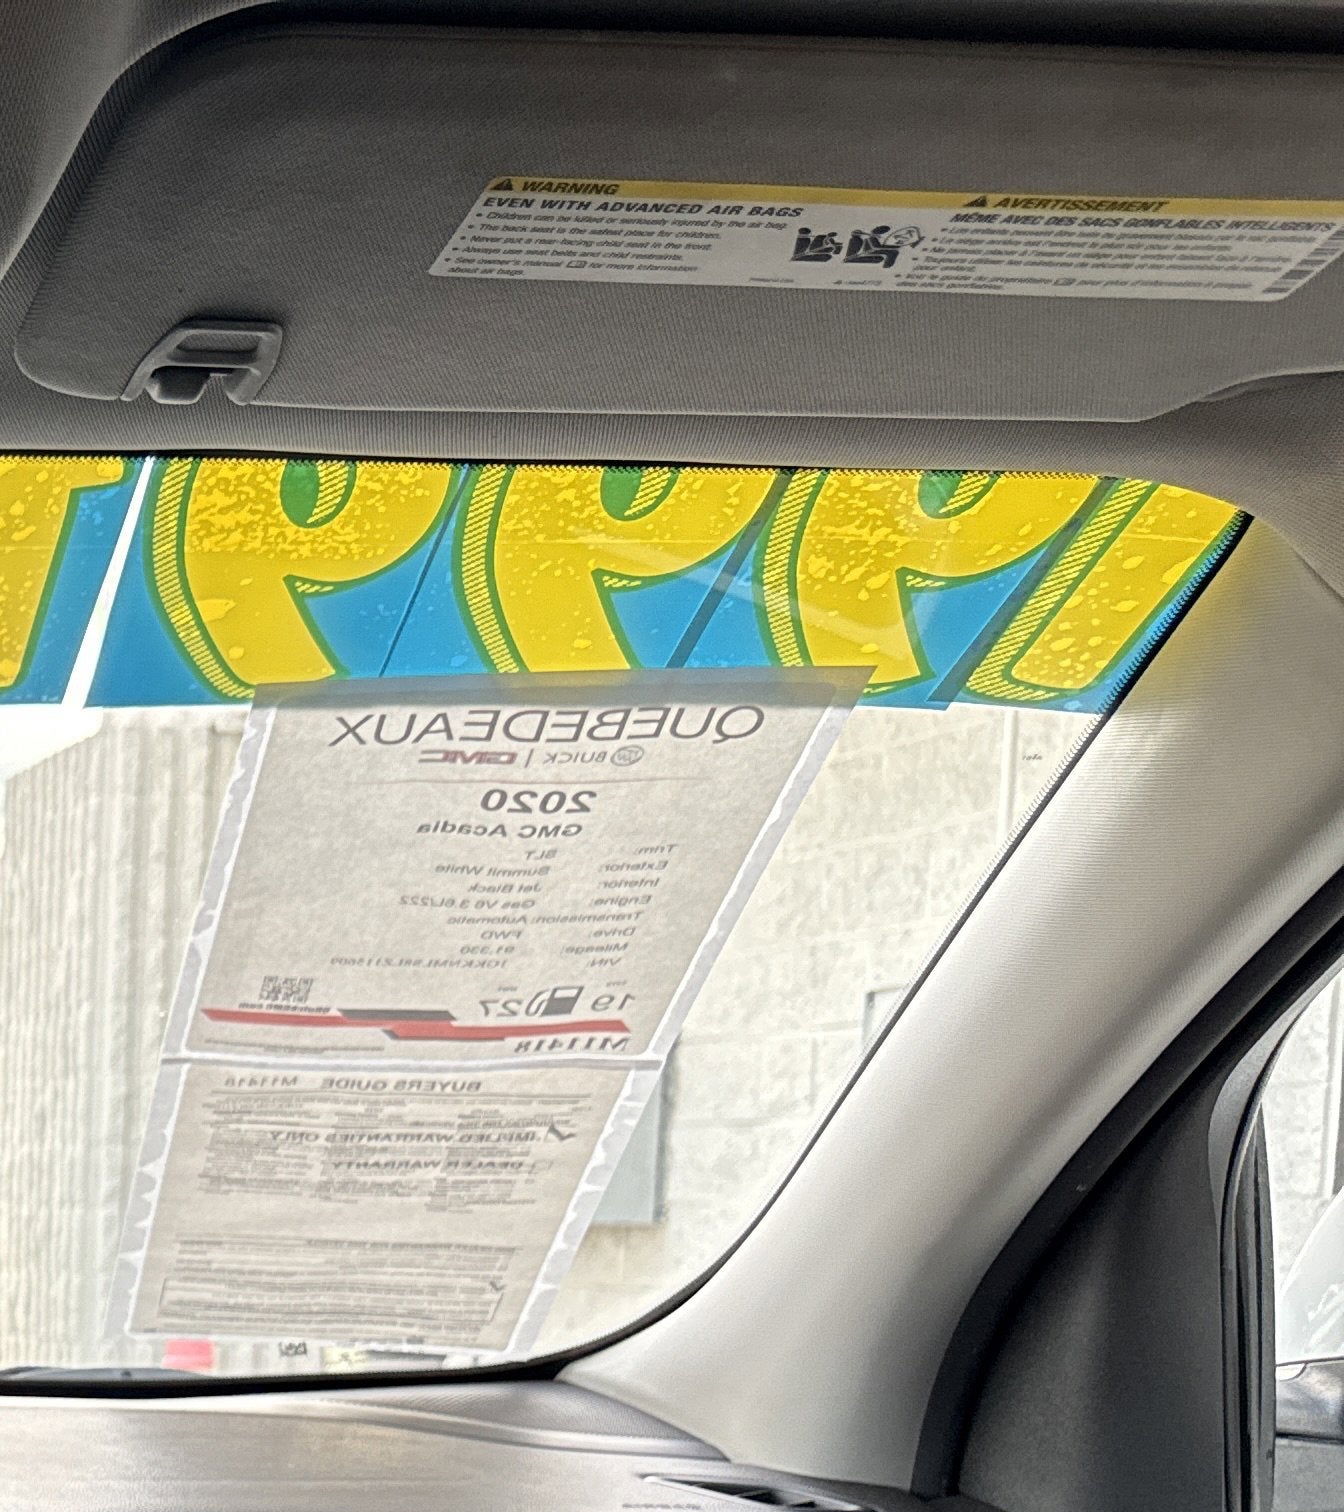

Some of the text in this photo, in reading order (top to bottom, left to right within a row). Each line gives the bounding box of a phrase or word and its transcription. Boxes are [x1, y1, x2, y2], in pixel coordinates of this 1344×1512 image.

[522, 181, 619, 195] WARNING
[483, 197, 804, 217] EVEN WITH ADVANCED AIR BAGS
[993, 197, 1170, 212] AVERTISSEMENT
[950, 212, 1337, 232] MÊME AVEC DES SACS GONFLABLES INTELLIGENTS
